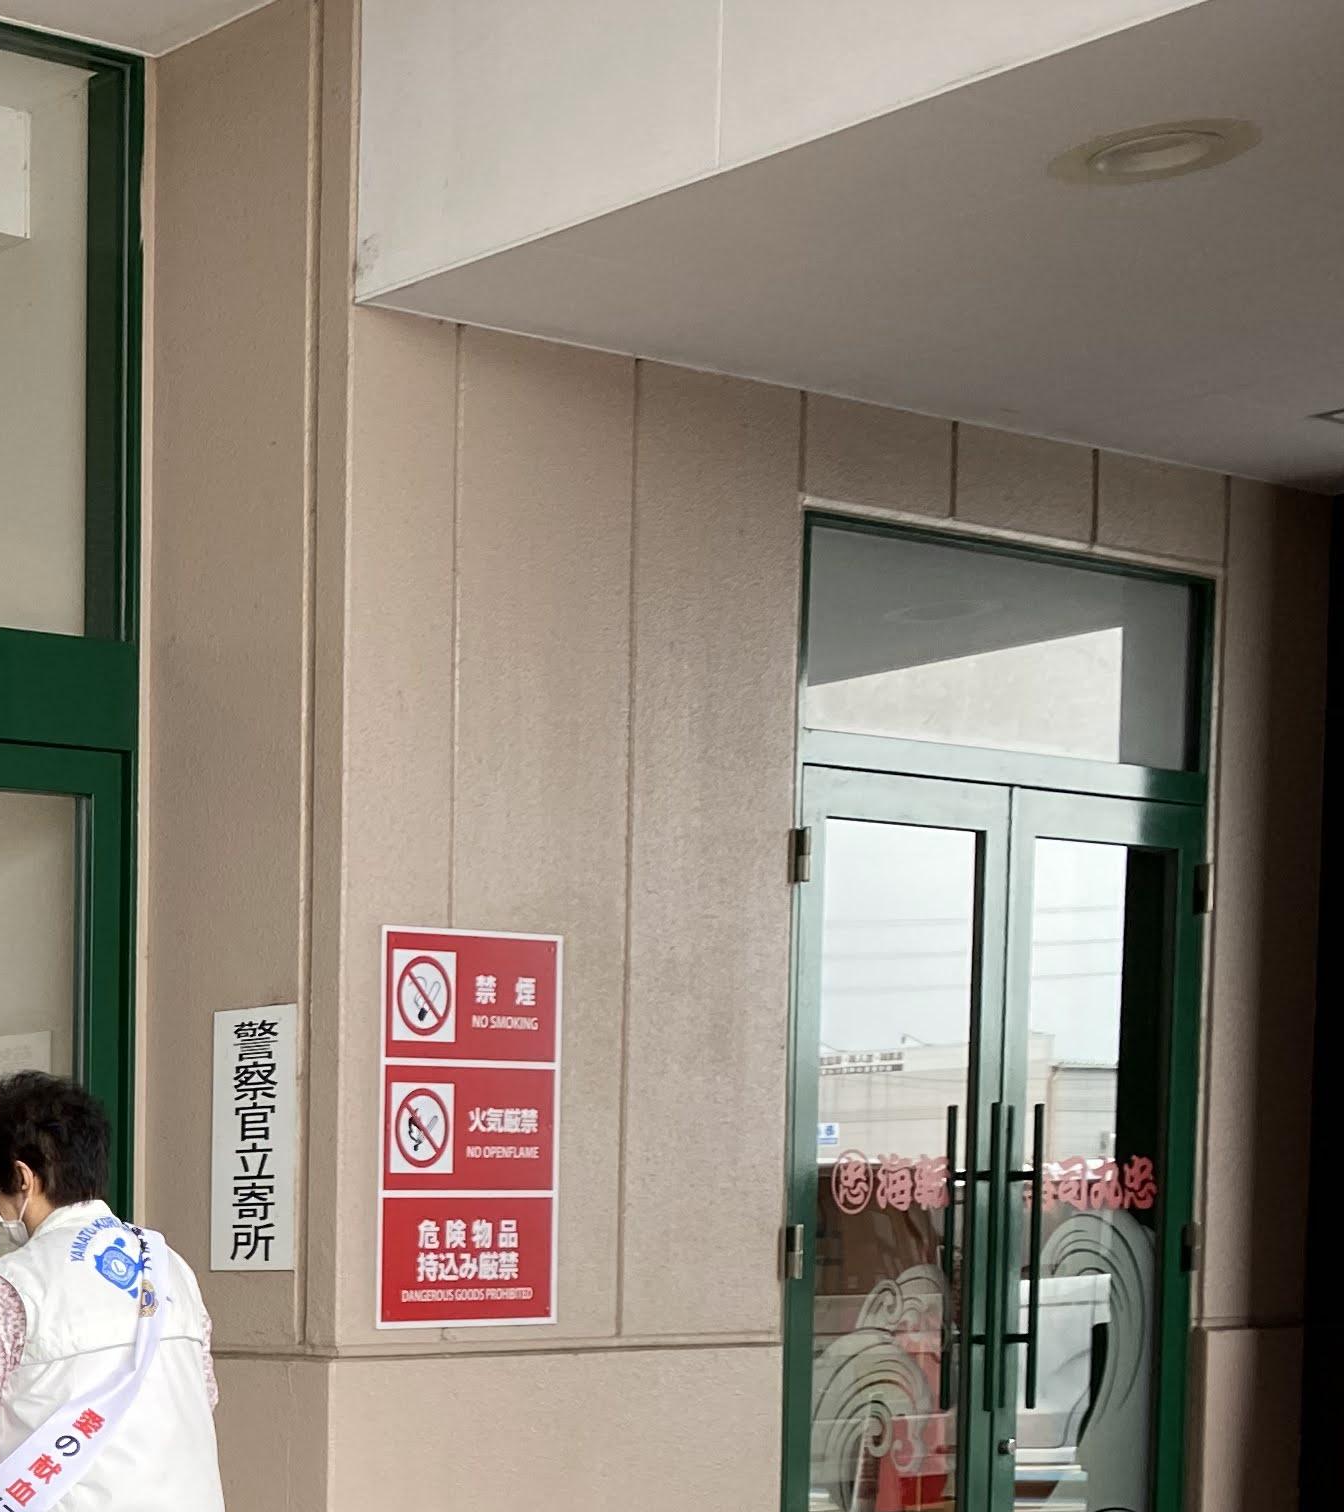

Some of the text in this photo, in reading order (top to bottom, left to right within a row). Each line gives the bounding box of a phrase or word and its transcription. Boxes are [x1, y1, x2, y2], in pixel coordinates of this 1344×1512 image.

[490, 1016, 539, 1030] SMOKING
[230, 1019, 278, 1262] 警察官立寄所
[417, 1251, 519, 1282] 持込み厳禁
